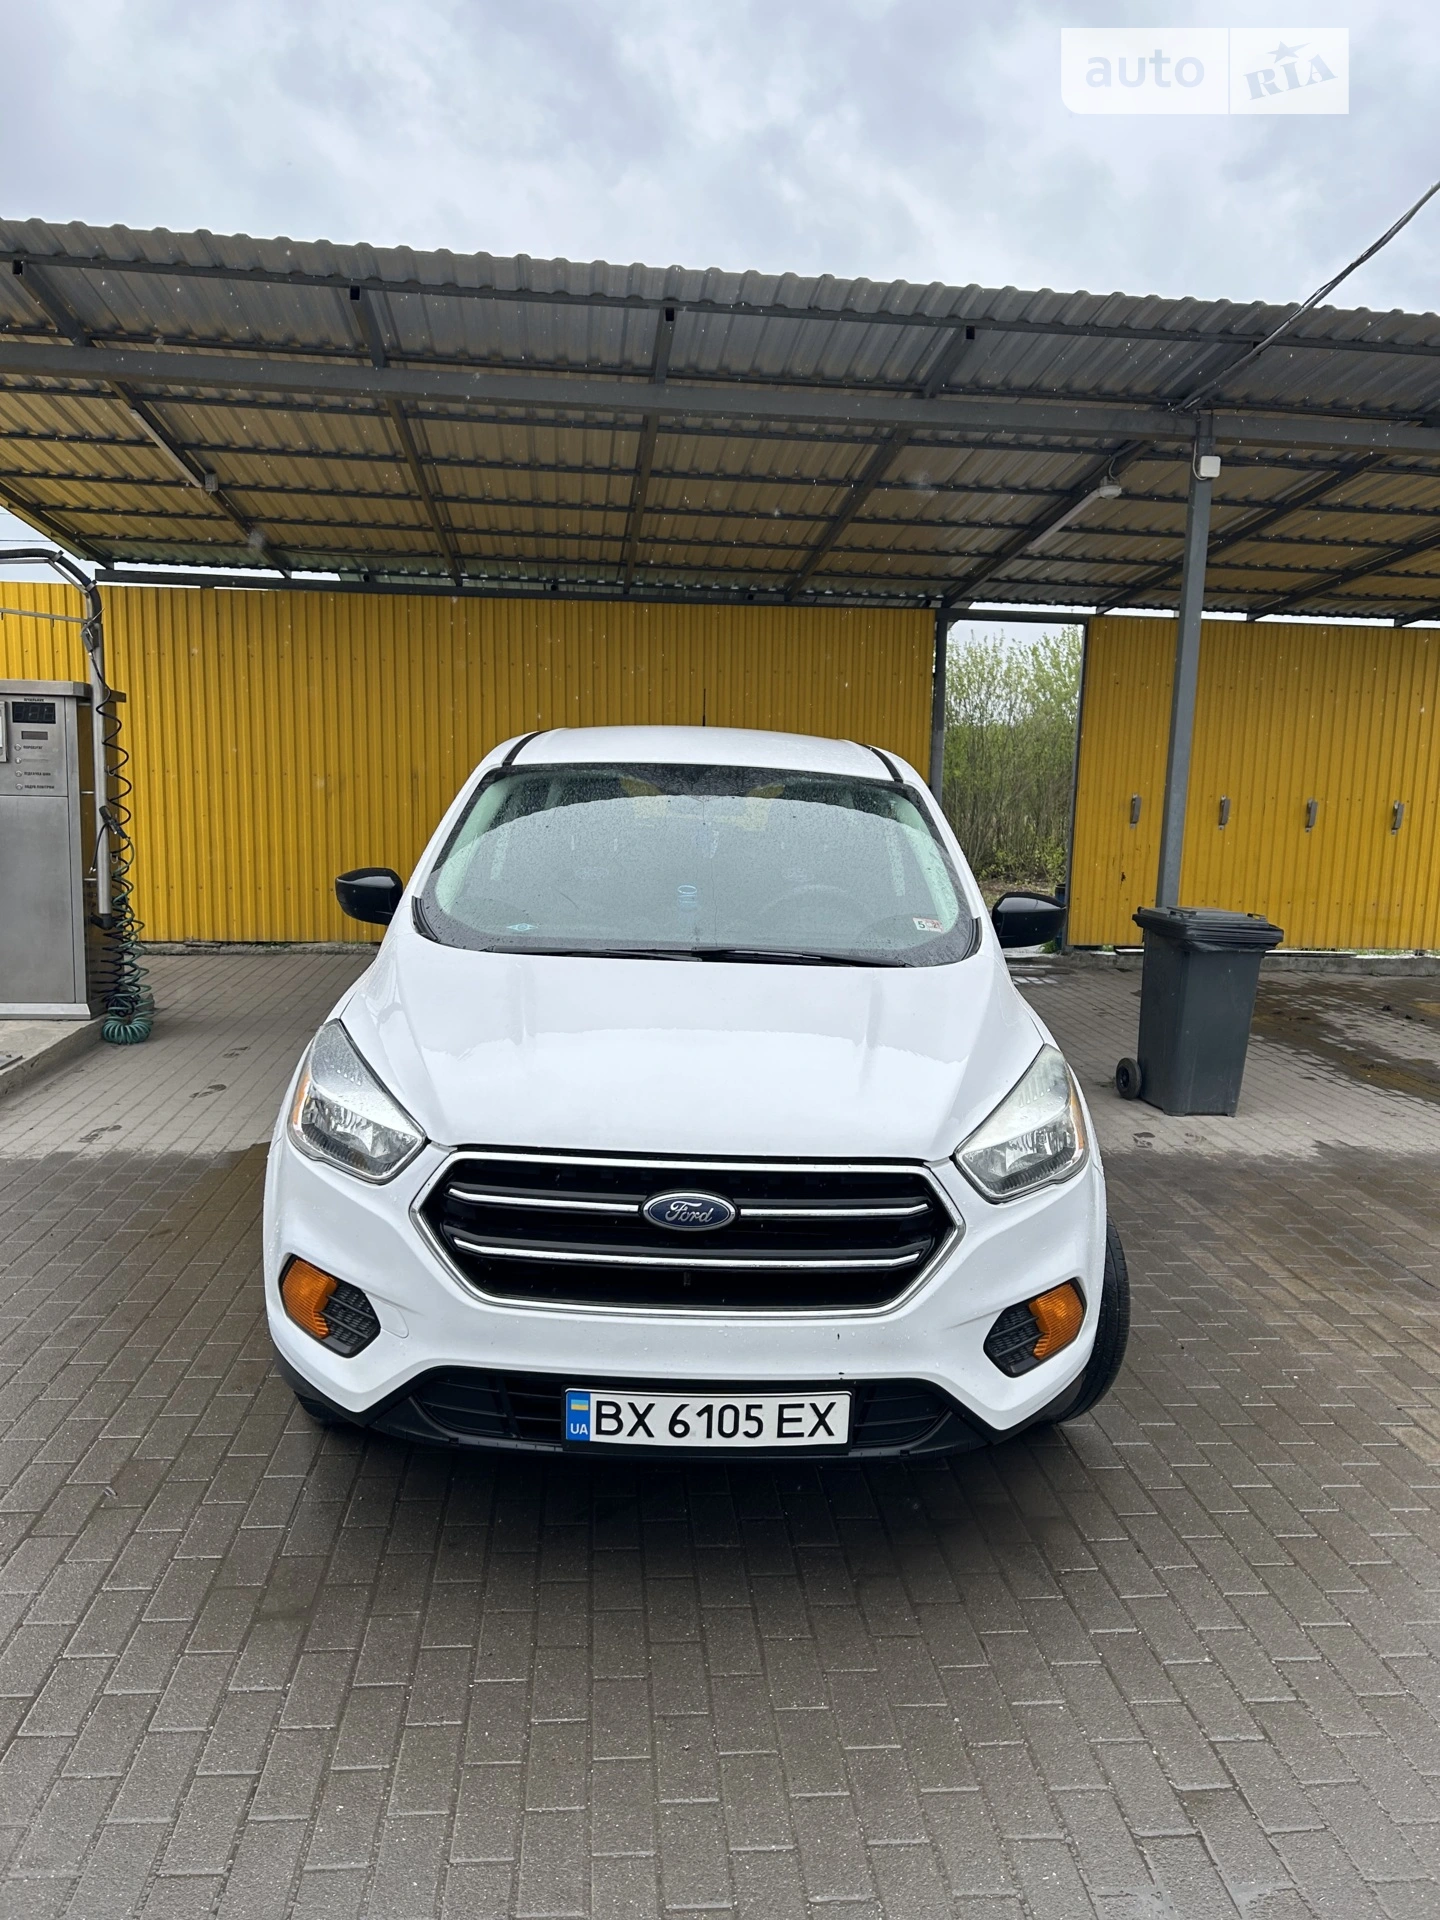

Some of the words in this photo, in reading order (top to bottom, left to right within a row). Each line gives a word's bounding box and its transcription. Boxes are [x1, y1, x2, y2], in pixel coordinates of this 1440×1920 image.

[664, 1200, 714, 1223] Ford
[570, 1423, 589, 1436] UA
[595, 1400, 656, 1438] BX
[668, 1403, 764, 1439] 6105
[776, 1402, 837, 1438] EX
